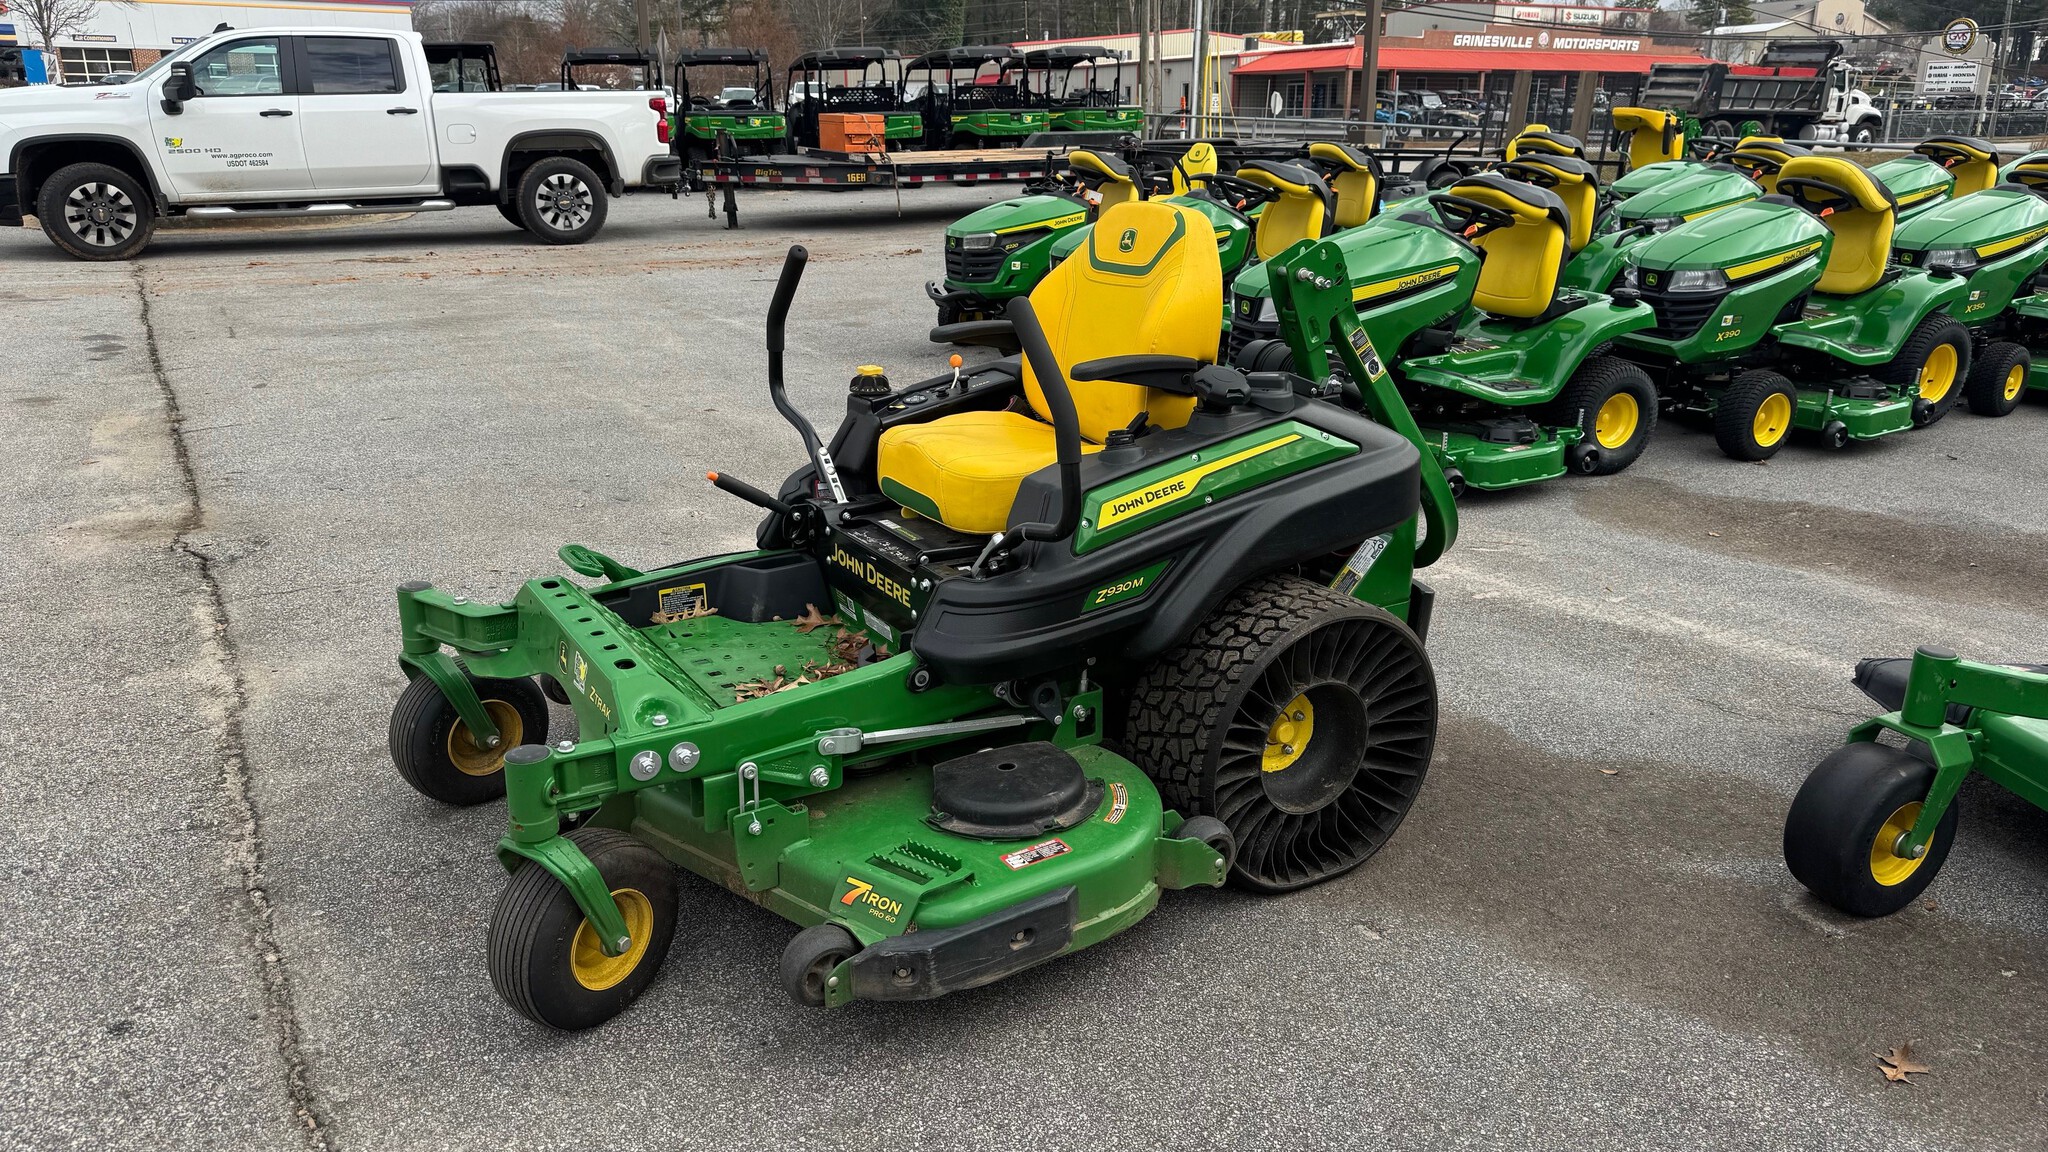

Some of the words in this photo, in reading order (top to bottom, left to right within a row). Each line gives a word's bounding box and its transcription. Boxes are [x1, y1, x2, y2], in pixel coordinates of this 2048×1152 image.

[1573, 13, 1600, 21] SUZUKI
[1453, 34, 1534, 49] GAINESVILLE
[1552, 37, 1641, 52] MOTORSPORTS
[211, 151, 273, 160] www.agproco.com
[846, 172, 866, 183] 16EH
[1067, 215, 1083, 224] DEERE
[1781, 254, 1797, 265] JOHN
[1795, 246, 1812, 259] DEERE
[1396, 279, 1418, 291] JOHN
[1417, 270, 1442, 284] DEERE
[1965, 302, 1986, 314] X350
[1716, 329, 1741, 342] X390
[1111, 496, 1145, 517] JOHN
[1144, 480, 1187, 504] DEERE
[831, 542, 865, 579] JOHN
[866, 561, 912, 609] DEERE
[1095, 576, 1145, 604] Z930M
[589, 685, 612, 721] ZTRAK
[868, 908, 884, 919] PRO
[884, 914, 897, 924] 60
